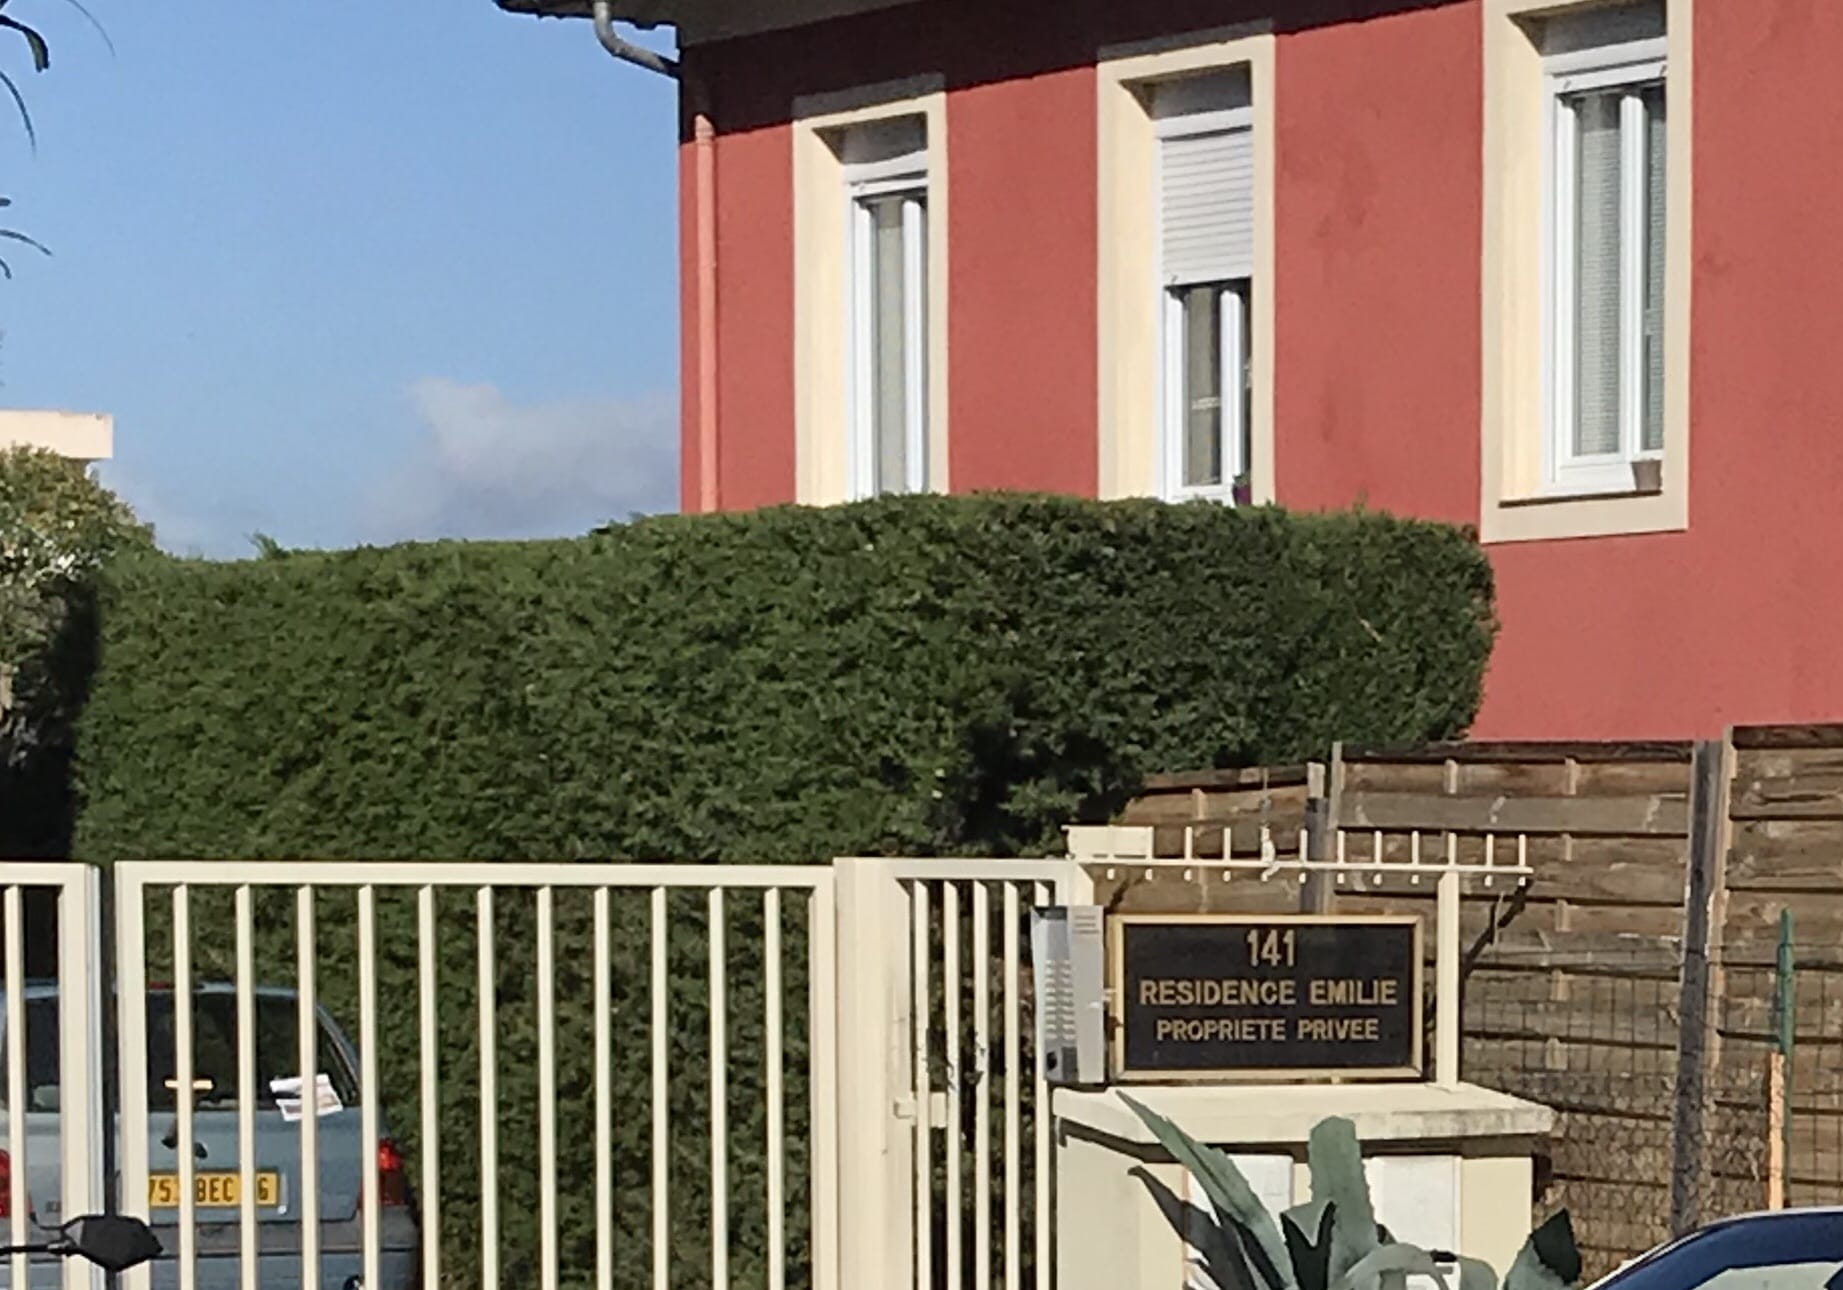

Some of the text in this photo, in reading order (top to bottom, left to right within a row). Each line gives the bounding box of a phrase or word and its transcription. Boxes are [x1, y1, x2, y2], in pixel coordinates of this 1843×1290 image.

[1246, 929, 1297, 968] 141
[1139, 979, 1398, 1006] RESIDENCE EMILIE
[1156, 1018, 1380, 1041] PROPRIETE PRIVEE
[148, 1178, 180, 1202] 75
